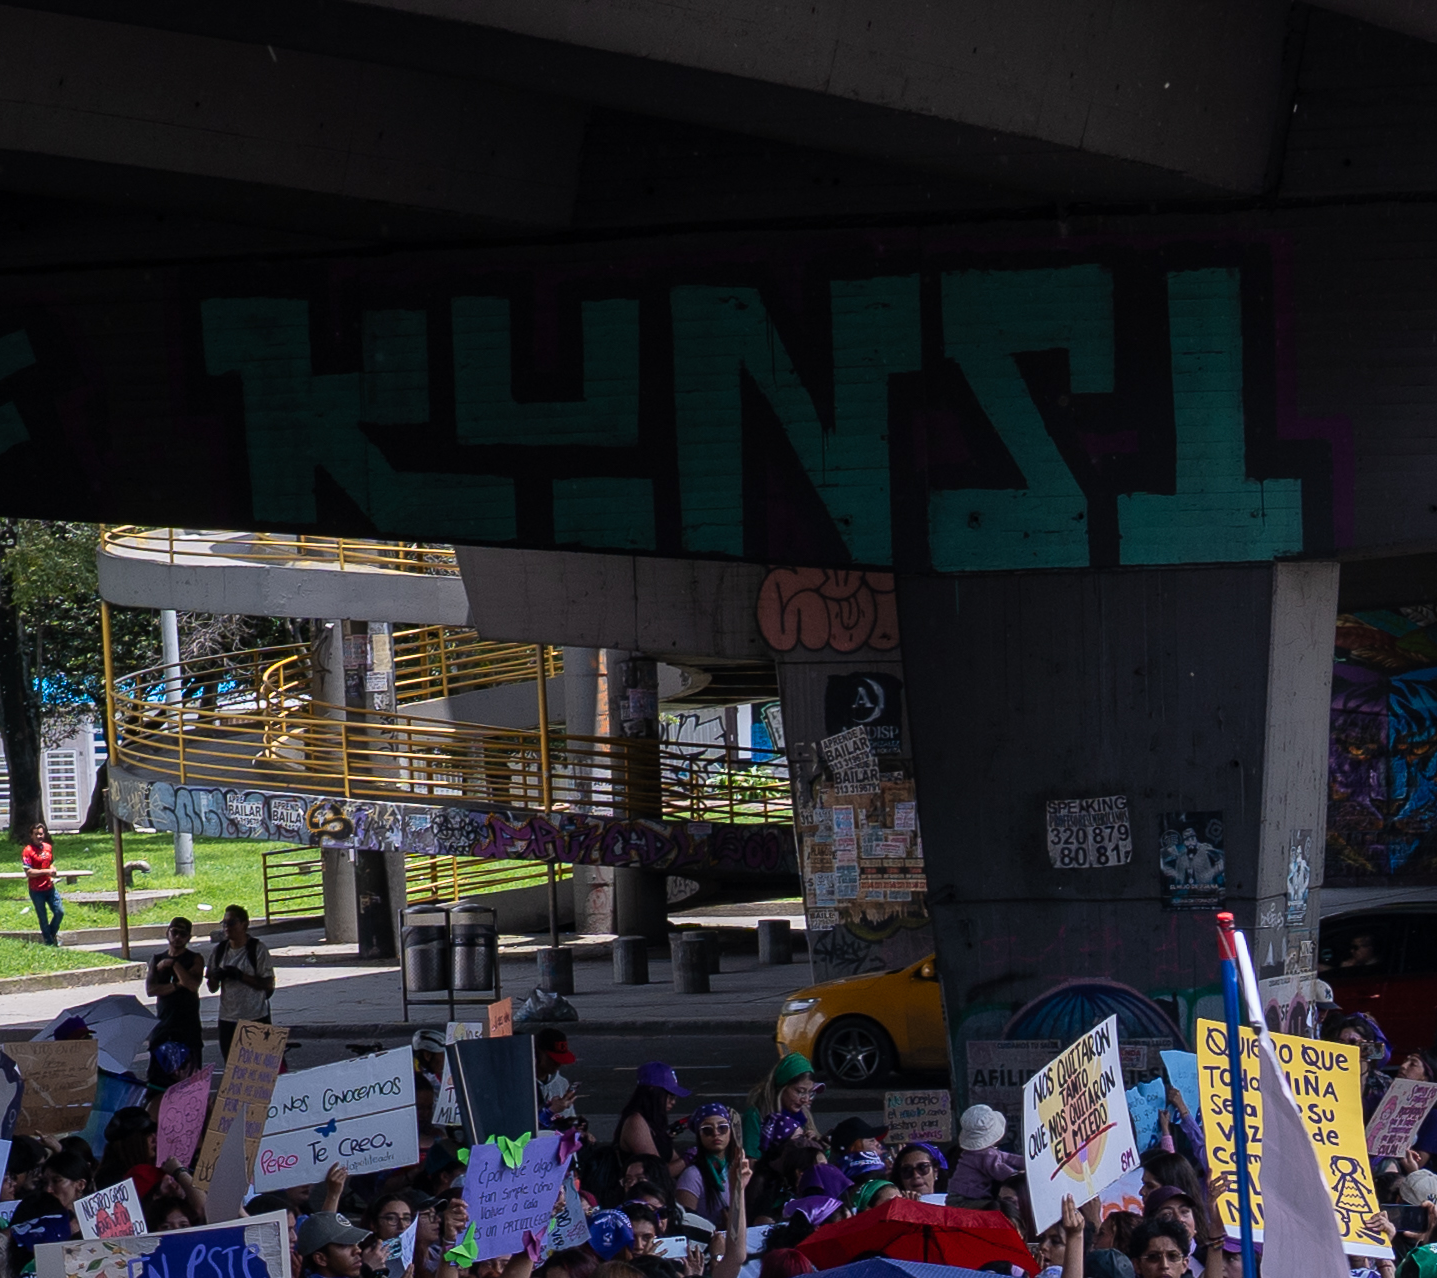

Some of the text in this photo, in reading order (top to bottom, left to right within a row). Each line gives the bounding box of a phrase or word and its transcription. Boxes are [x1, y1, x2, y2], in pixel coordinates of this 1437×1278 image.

[824, 738, 871, 764] BAILAR
[832, 769, 880, 785] BAILAR
[1045, 795, 1129, 817] SPEAKING
[1048, 823, 1131, 847] 320 879
[1059, 845, 1089, 868] 80
[1031, 1021, 1112, 1112] NOS QUITARON
[1026, 1131, 1048, 1163] QUE
[1047, 1111, 1069, 1145] NOS
[1068, 1064, 1117, 1125] QUITARON
[1053, 1140, 1073, 1167] EL
[1071, 1102, 1109, 1153] MIEDO
[1120, 1147, 1138, 1173] 8M
